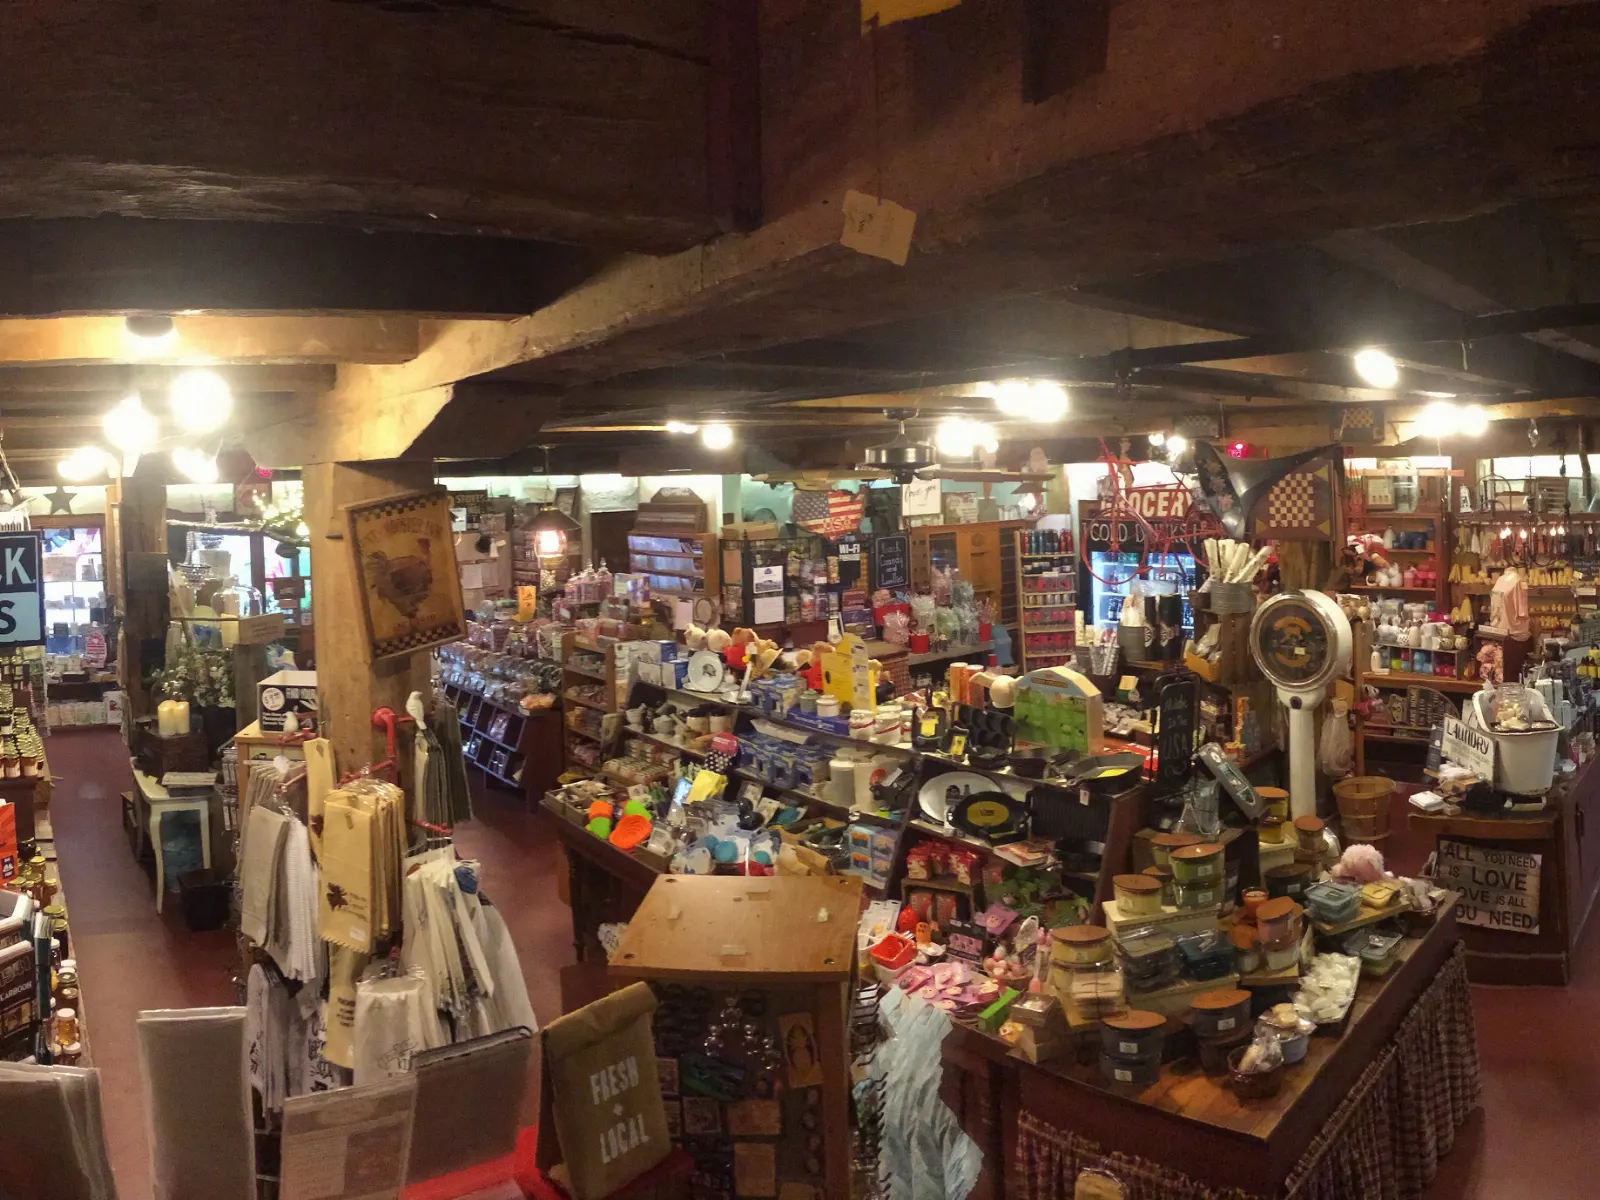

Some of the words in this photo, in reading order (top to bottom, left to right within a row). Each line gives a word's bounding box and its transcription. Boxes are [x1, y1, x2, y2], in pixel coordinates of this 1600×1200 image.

[823, 516, 851, 531] USA
[1445, 843, 1474, 861] ALL
[1483, 850, 1506, 864] YOU
[1508, 855, 1537, 869] NEED
[1448, 865, 1460, 878] IS
[1472, 866, 1527, 892] LOVE
[1456, 886, 1490, 904] OVE
[1508, 895, 1526, 909] ALL
[1455, 903, 1477, 921] OU
[1489, 911, 1532, 930] NEED
[590, 1056, 639, 1106] FRESH
[600, 1112, 650, 1164] LOCAL
